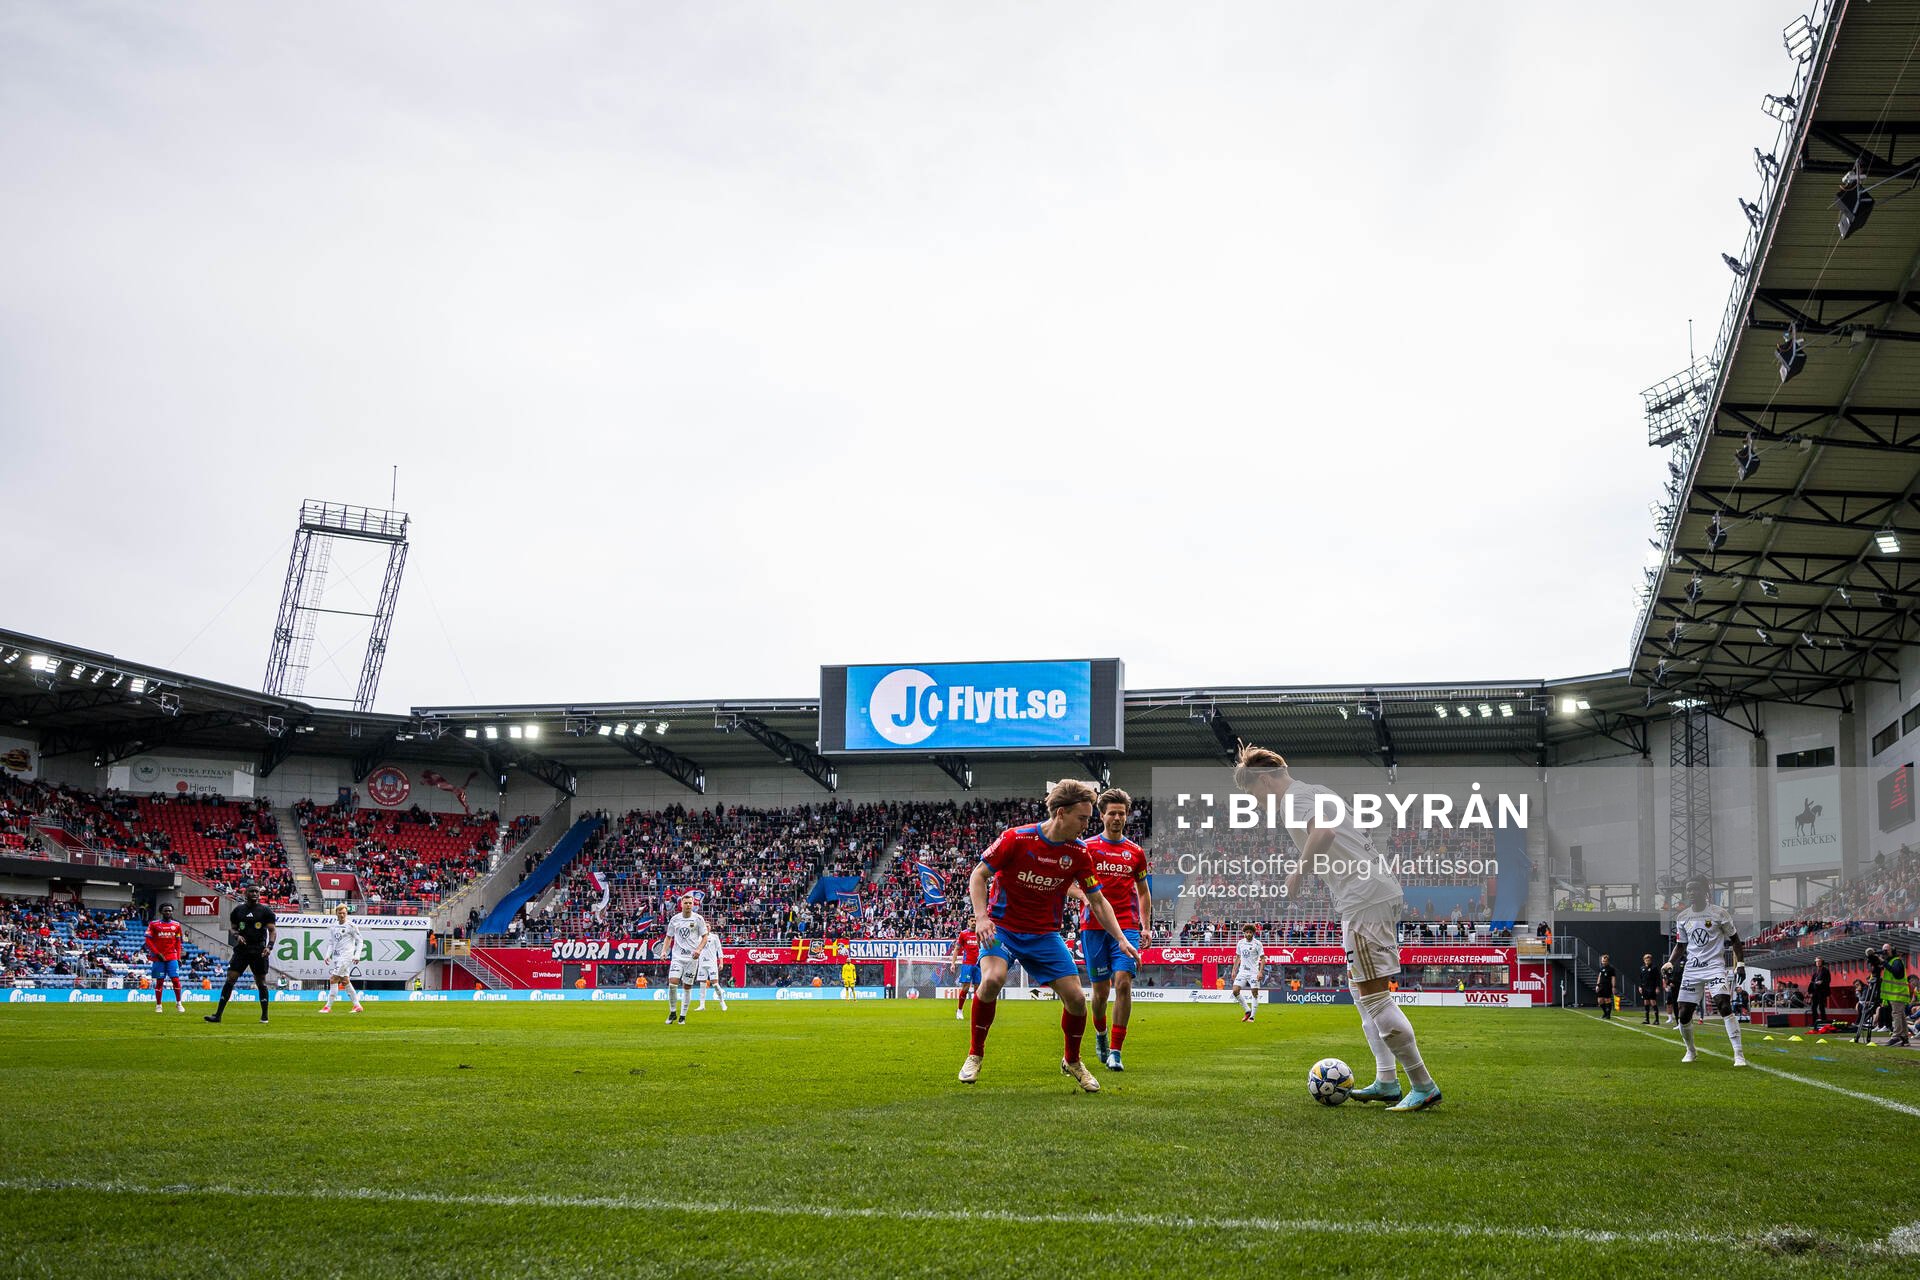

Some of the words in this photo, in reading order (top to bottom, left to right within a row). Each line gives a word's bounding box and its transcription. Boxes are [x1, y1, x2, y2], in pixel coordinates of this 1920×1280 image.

[948, 685, 1067, 724] Flytt.se
[189, 783, 217, 793] Hjerta
[1781, 834, 1837, 848] STENBOCKEN
[1096, 861, 1123, 872] akea
[1017, 870, 1052, 887] akea
[185, 906, 210, 915] PUMA
[275, 916, 318, 925] LIPPANS
[277, 931, 373, 961] aka
[552, 939, 610, 959] SÖDRA
[615, 939, 649, 960] STÅ
[850, 942, 947, 958] SKÅNEPÅGARNA
[748, 949, 780, 961] Carlsberg
[1162, 949, 1196, 962] Carlsberg
[1286, 991, 1335, 1003] kondektor
